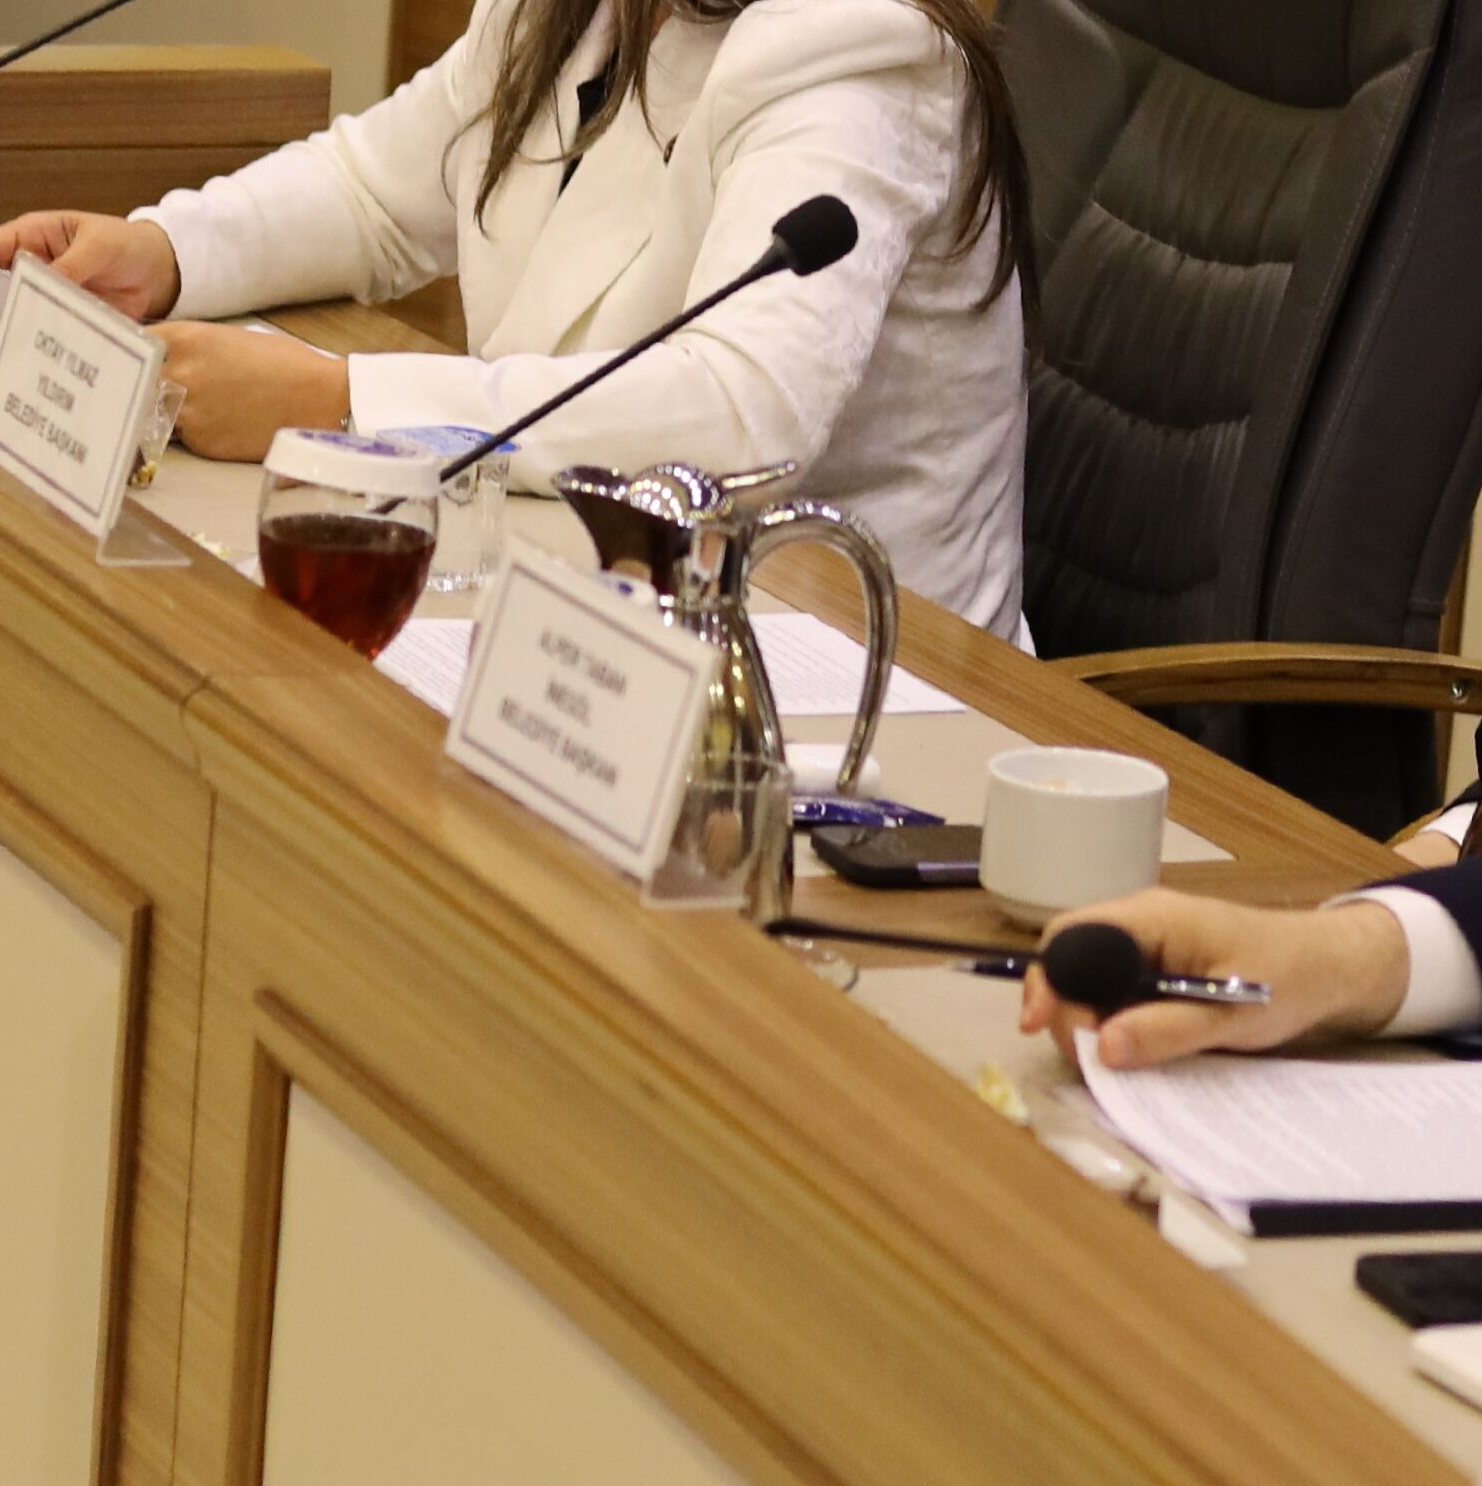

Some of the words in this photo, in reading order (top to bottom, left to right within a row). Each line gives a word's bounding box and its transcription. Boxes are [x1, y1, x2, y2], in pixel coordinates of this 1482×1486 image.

[33, 328, 66, 364] OKTAY
[64, 349, 100, 389] YILMAZ
[3, 391, 49, 439] BELEDİYE
[47, 422, 88, 464] BAŞKANI
[498, 696, 562, 756] BELEDİYE
